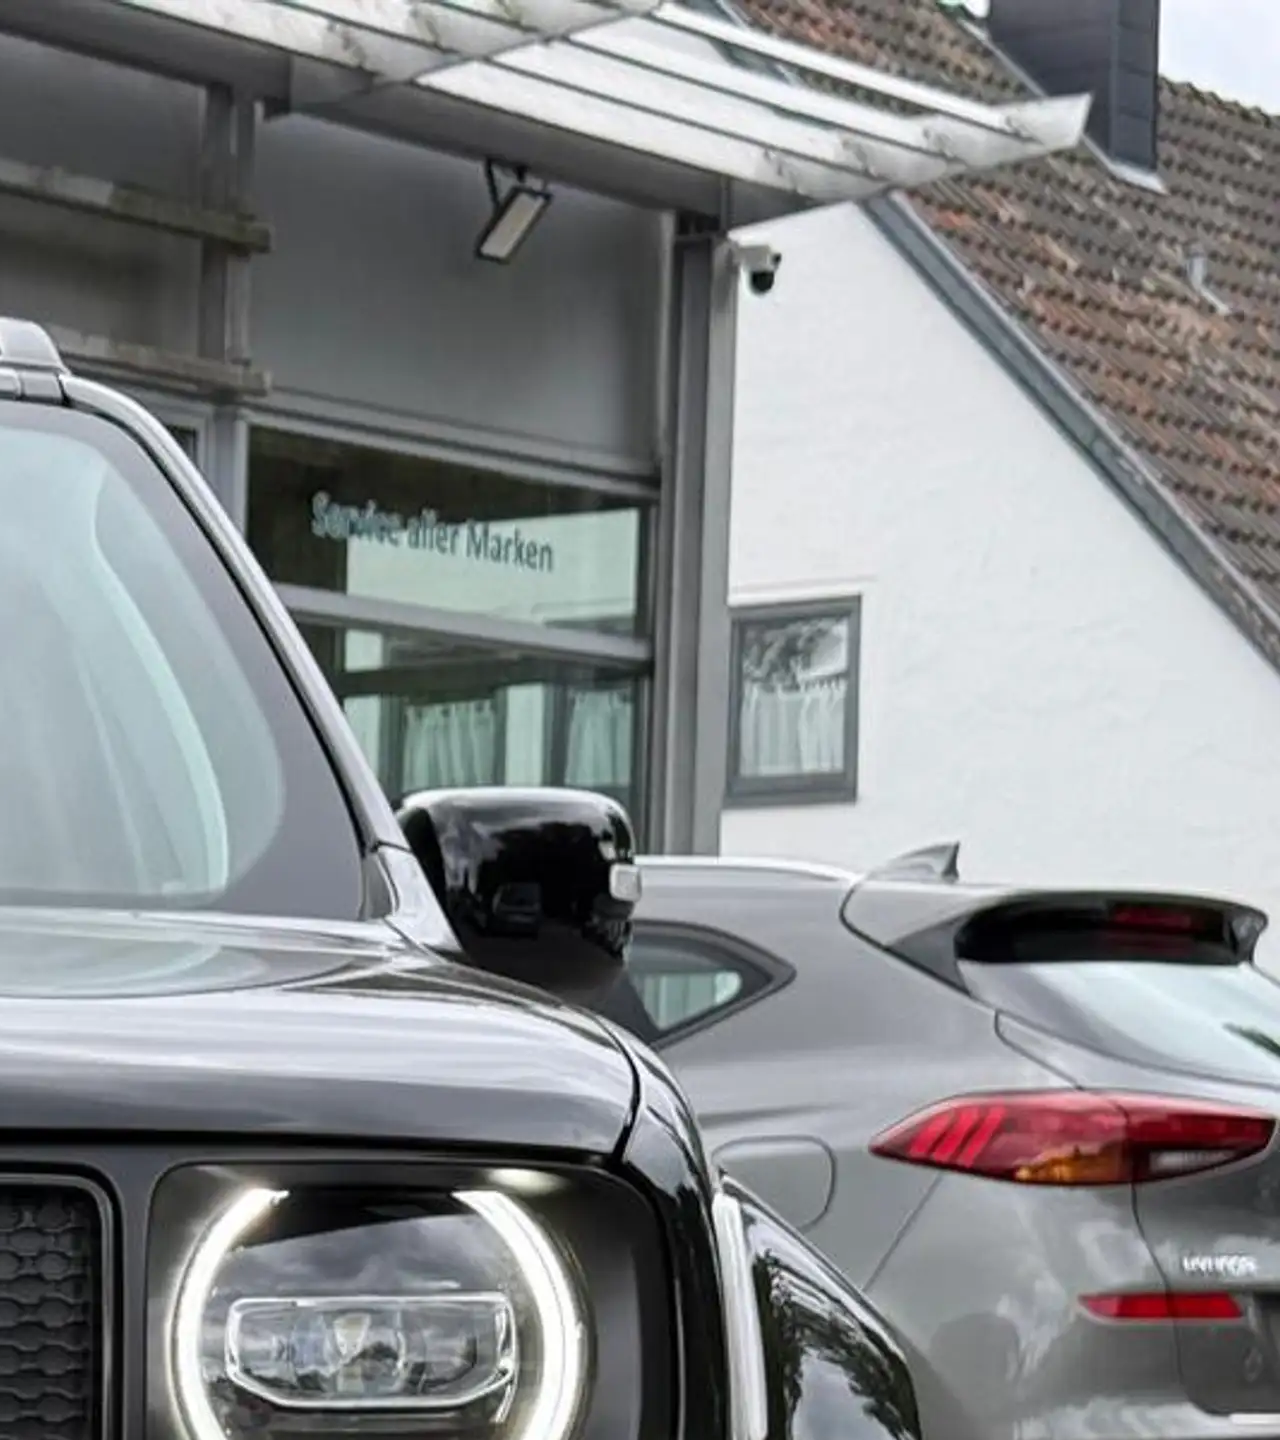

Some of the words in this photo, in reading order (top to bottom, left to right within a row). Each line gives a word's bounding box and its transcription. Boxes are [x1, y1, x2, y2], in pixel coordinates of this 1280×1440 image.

[311, 490, 401, 547] Service
[406, 508, 460, 556] aller
[464, 518, 554, 572] Marken
